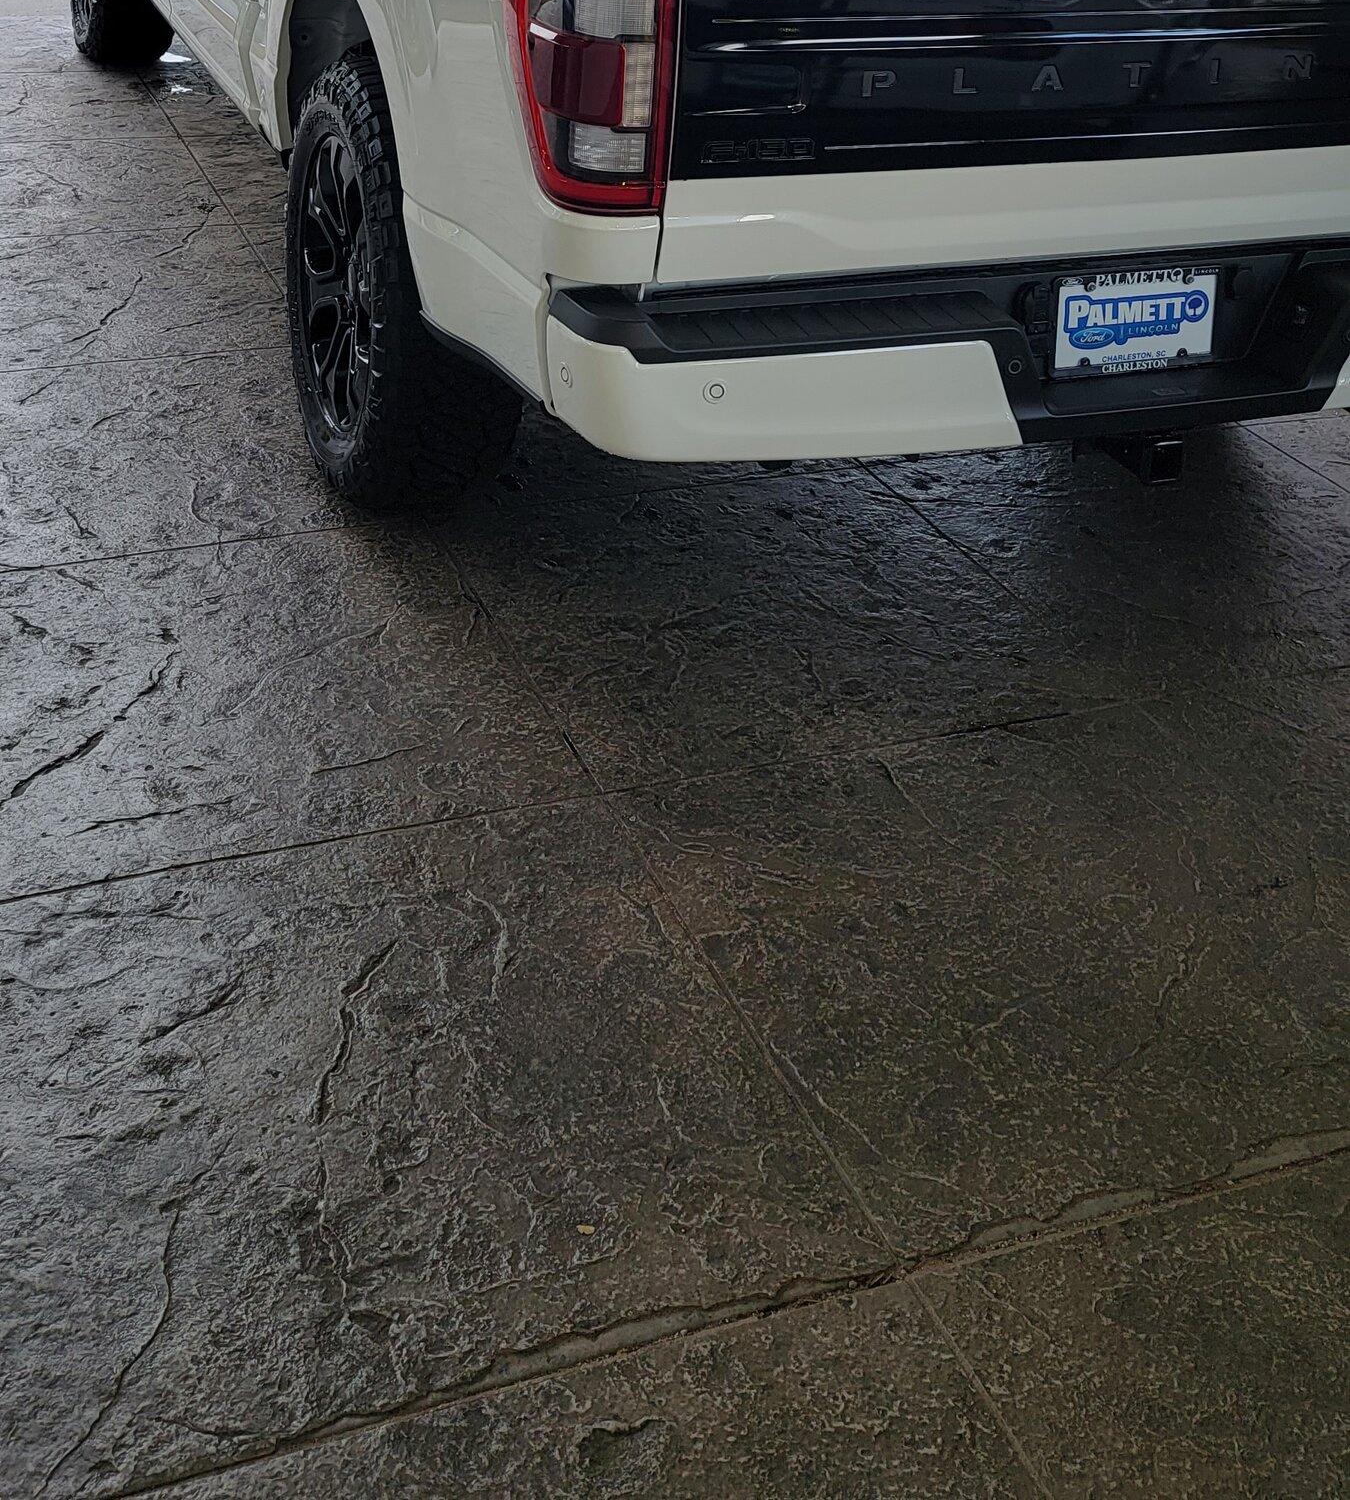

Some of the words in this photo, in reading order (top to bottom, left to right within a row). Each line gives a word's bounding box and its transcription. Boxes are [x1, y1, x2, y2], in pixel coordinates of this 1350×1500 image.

[1128, 323, 1179, 336] LINCOLN
[1080, 331, 1106, 343] Ford
[1102, 352, 1152, 363] CHARLESTON,
[1156, 350, 1167, 359] SC
[1102, 359, 1169, 374] CHARLESTON
